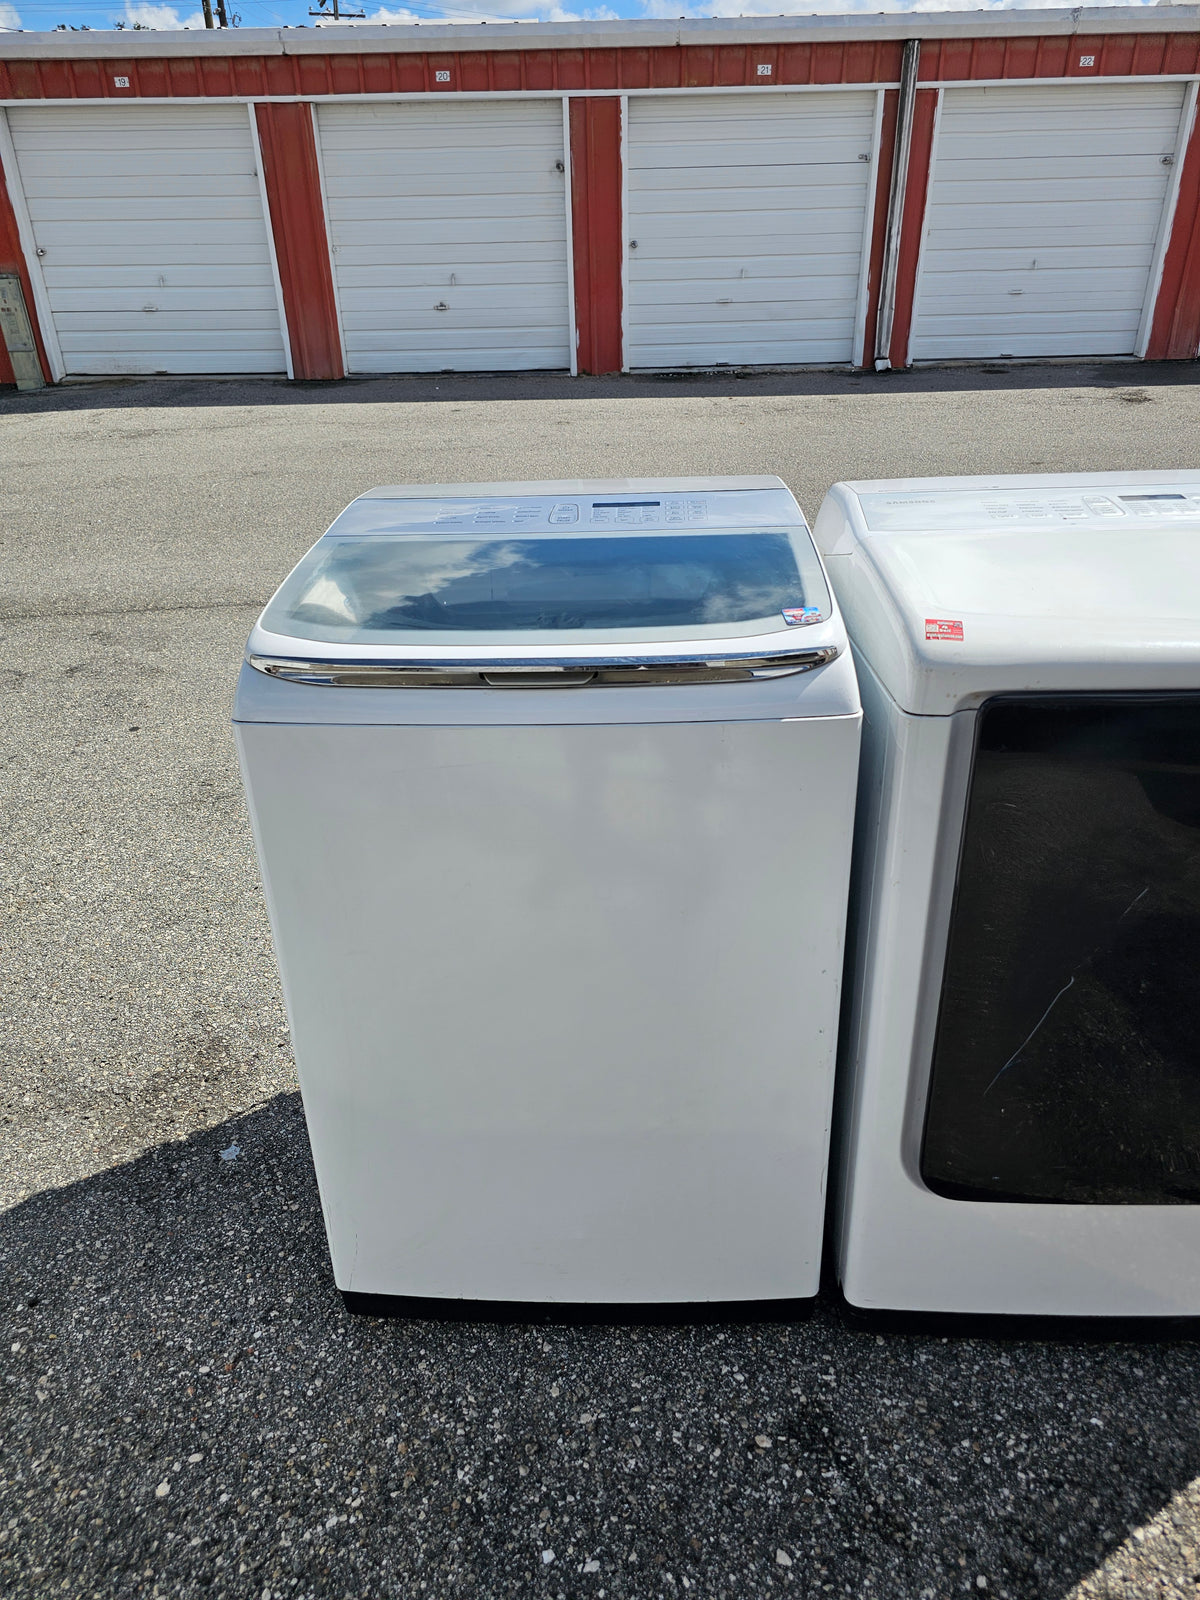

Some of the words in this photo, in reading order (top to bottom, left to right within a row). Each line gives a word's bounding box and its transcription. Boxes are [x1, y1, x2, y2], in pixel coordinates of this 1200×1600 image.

[1081, 57, 1093, 66] 22
[760, 66, 769, 75] 21
[437, 72, 448, 81] 20
[118, 77, 126, 87] 19
